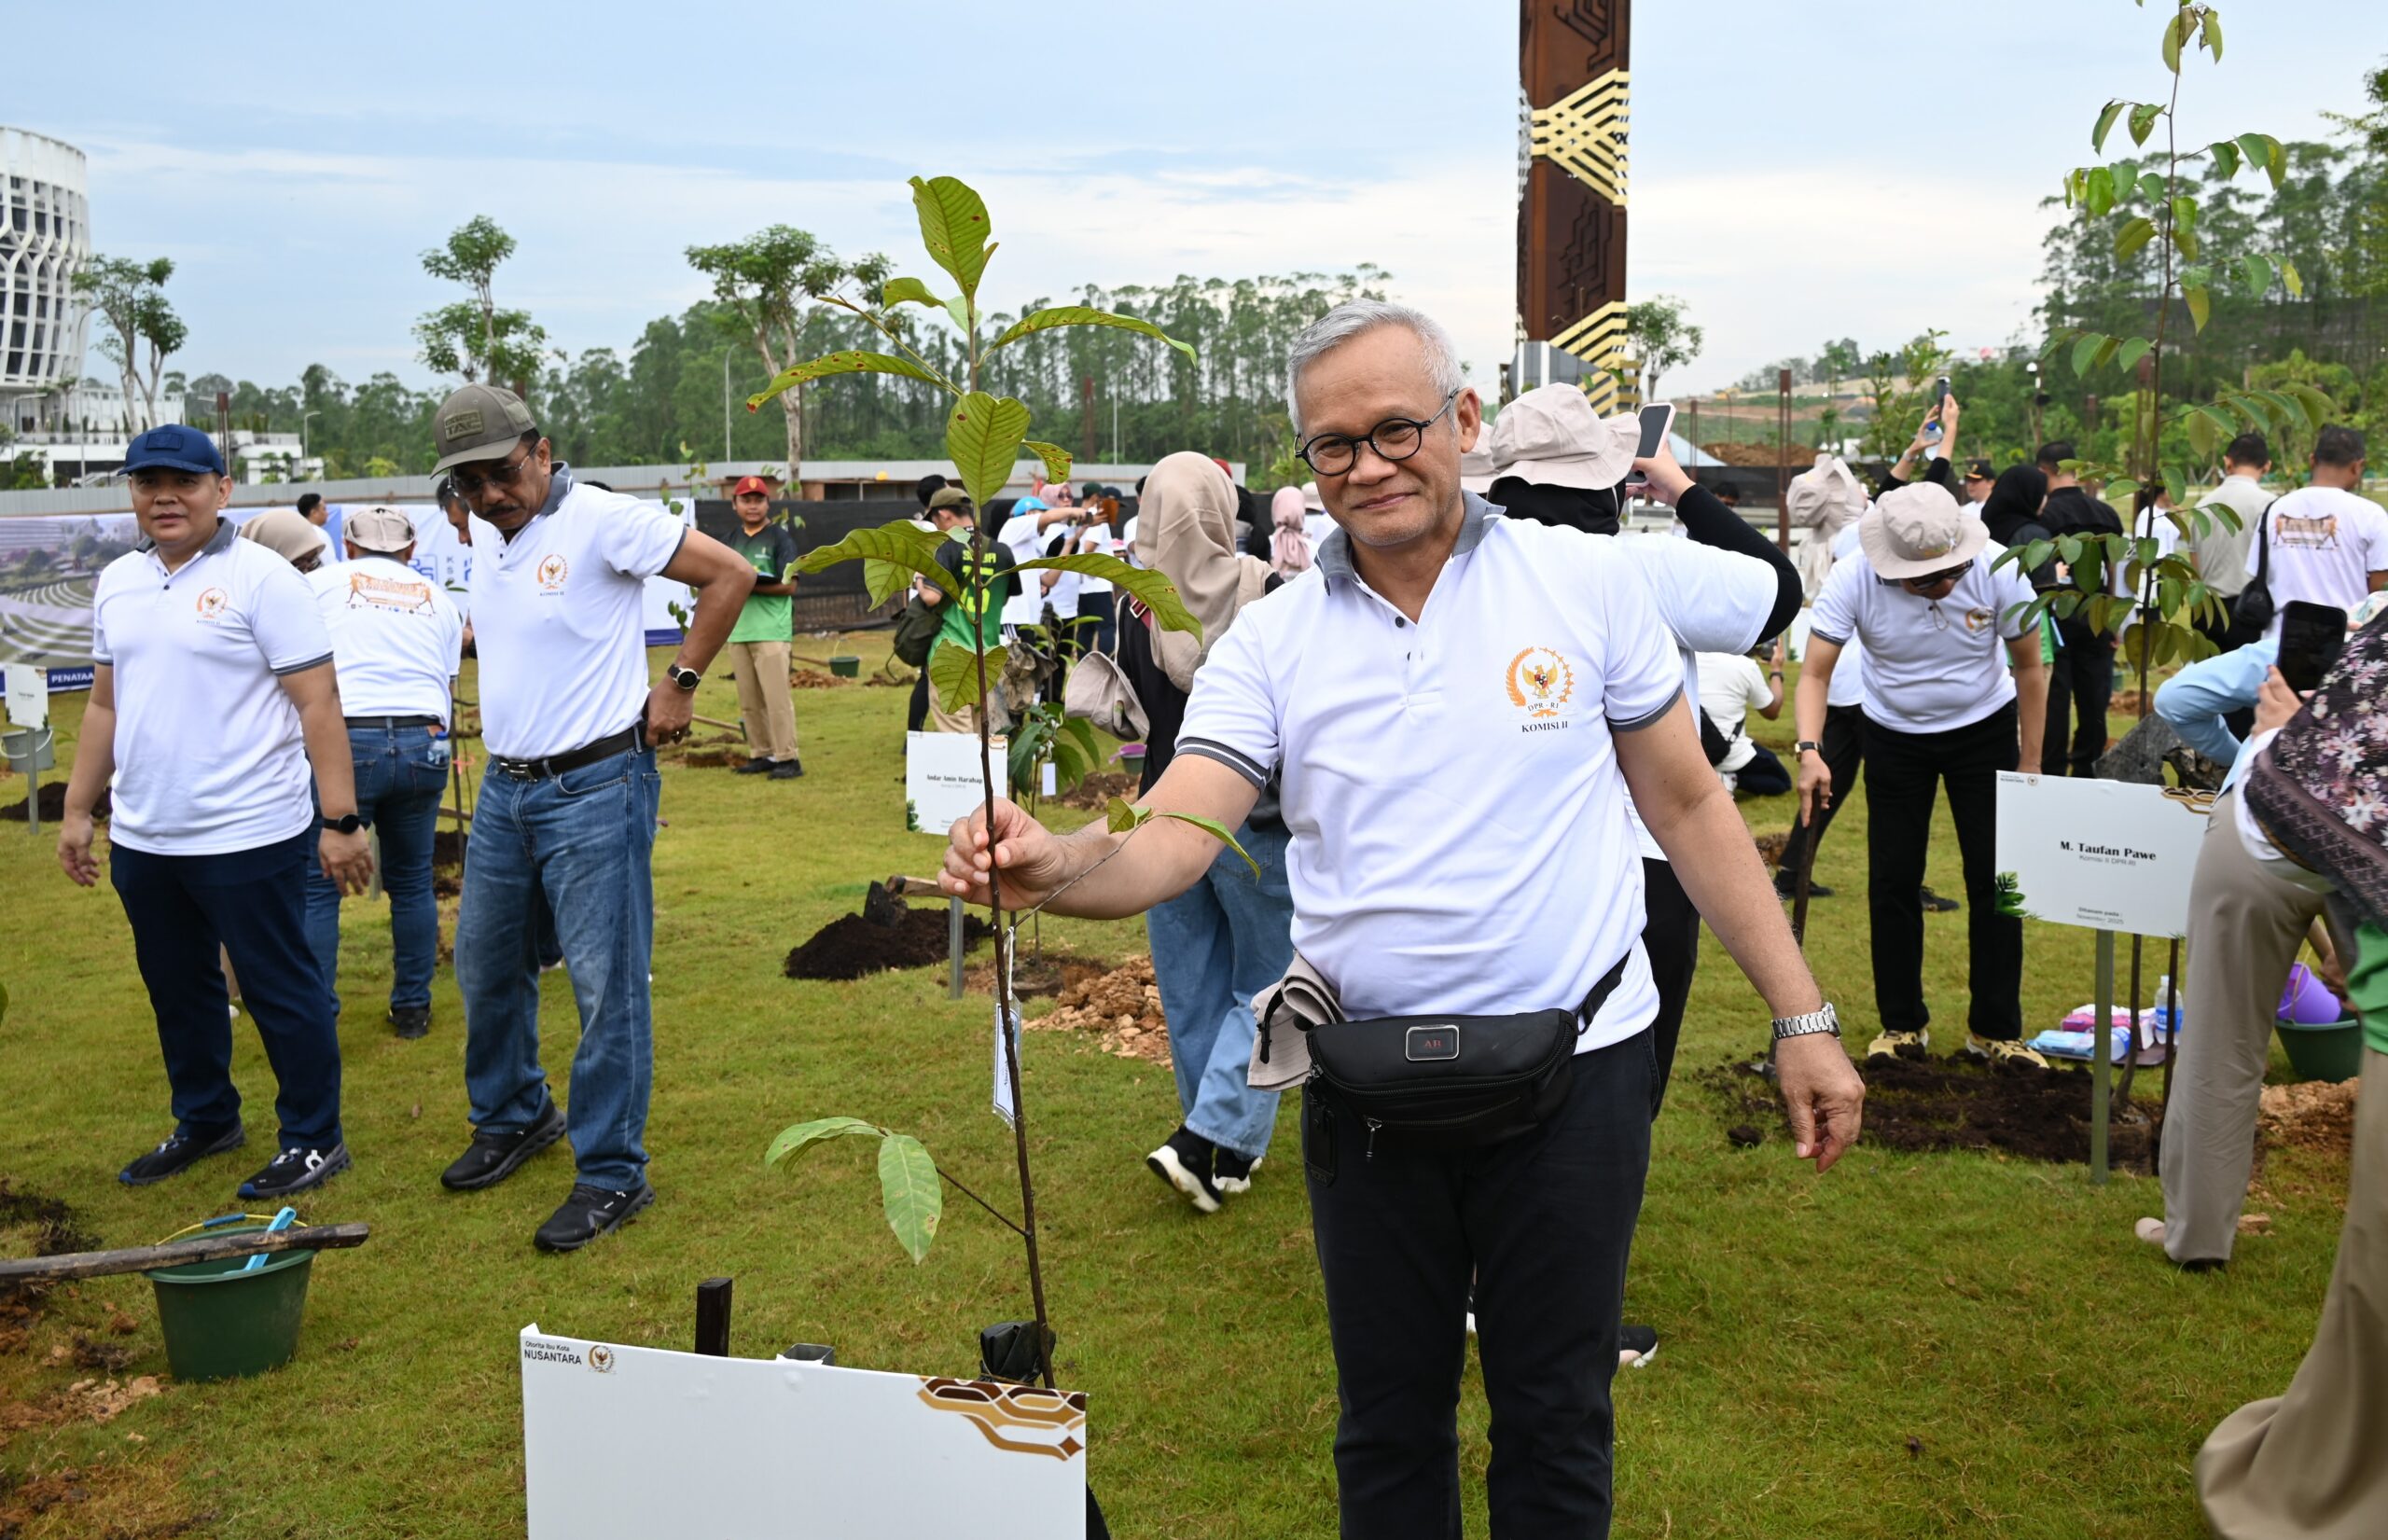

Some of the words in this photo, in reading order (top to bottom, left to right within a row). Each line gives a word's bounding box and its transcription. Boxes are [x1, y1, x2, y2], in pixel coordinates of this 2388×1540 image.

[1527, 702, 1544, 711] DPR
[1521, 721, 1559, 732] KOMISI
[2060, 840, 2075, 852] M.
[2078, 842, 2119, 856] Taufan
[2124, 848, 2157, 860] Pawe
[525, 1340, 546, 1350] Otorita
[524, 1349, 582, 1365] NUSANTARA
